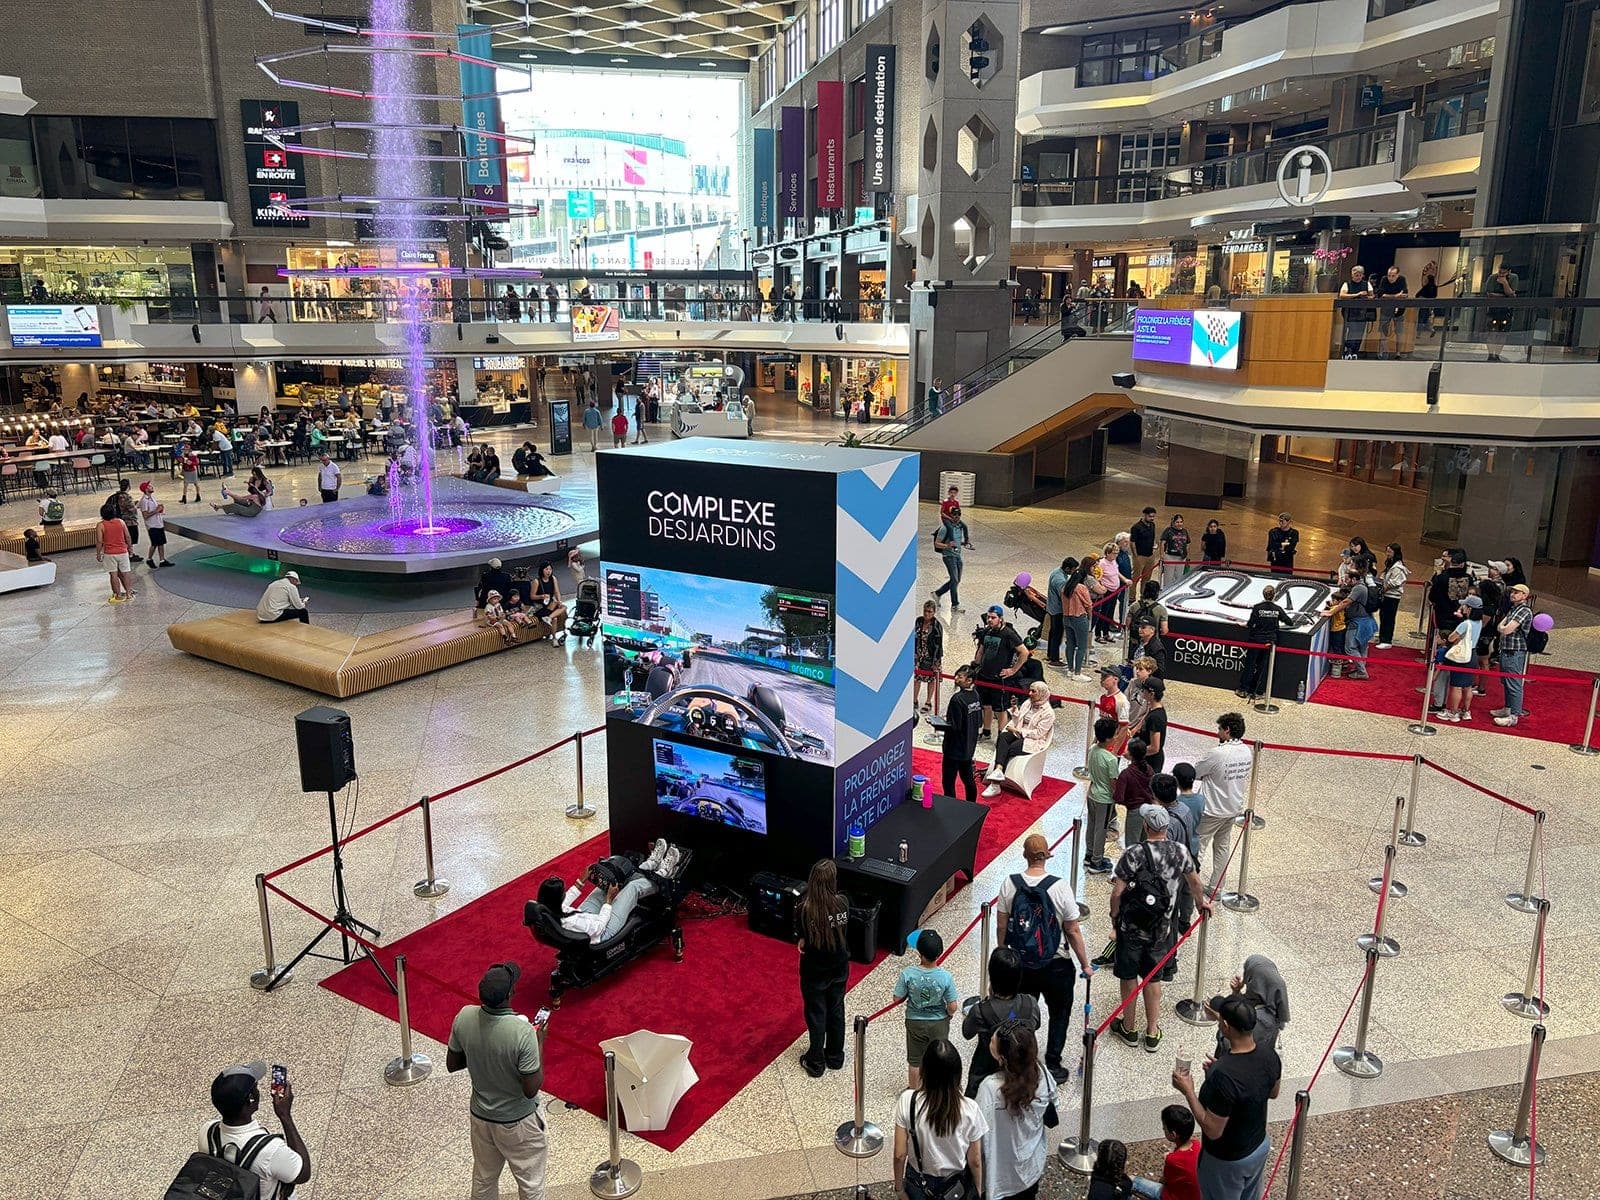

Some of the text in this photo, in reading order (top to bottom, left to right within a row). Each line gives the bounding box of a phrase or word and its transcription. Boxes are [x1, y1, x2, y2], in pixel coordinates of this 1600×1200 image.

[873, 56, 886, 186] Une seule destination
[269, 172, 296, 180] ROUTE
[826, 138, 835, 202] Restaurants
[760, 180, 769, 223] Boutiques
[789, 172, 798, 213] Services
[1221, 243, 1265, 255] TENDANCES
[647, 490, 776, 527] COMPLEXE
[649, 516, 776, 552] DESJARDINS
[1174, 638, 1248, 659] COMPLEX
[1174, 650, 1246, 672] DESJARDIN
[791, 664, 824, 680] aramco
[844, 739, 906, 797] PROLONGEZ
[844, 761, 907, 821] LA FRÉNÉSIE,
[876, 794, 892, 818] ICI.
